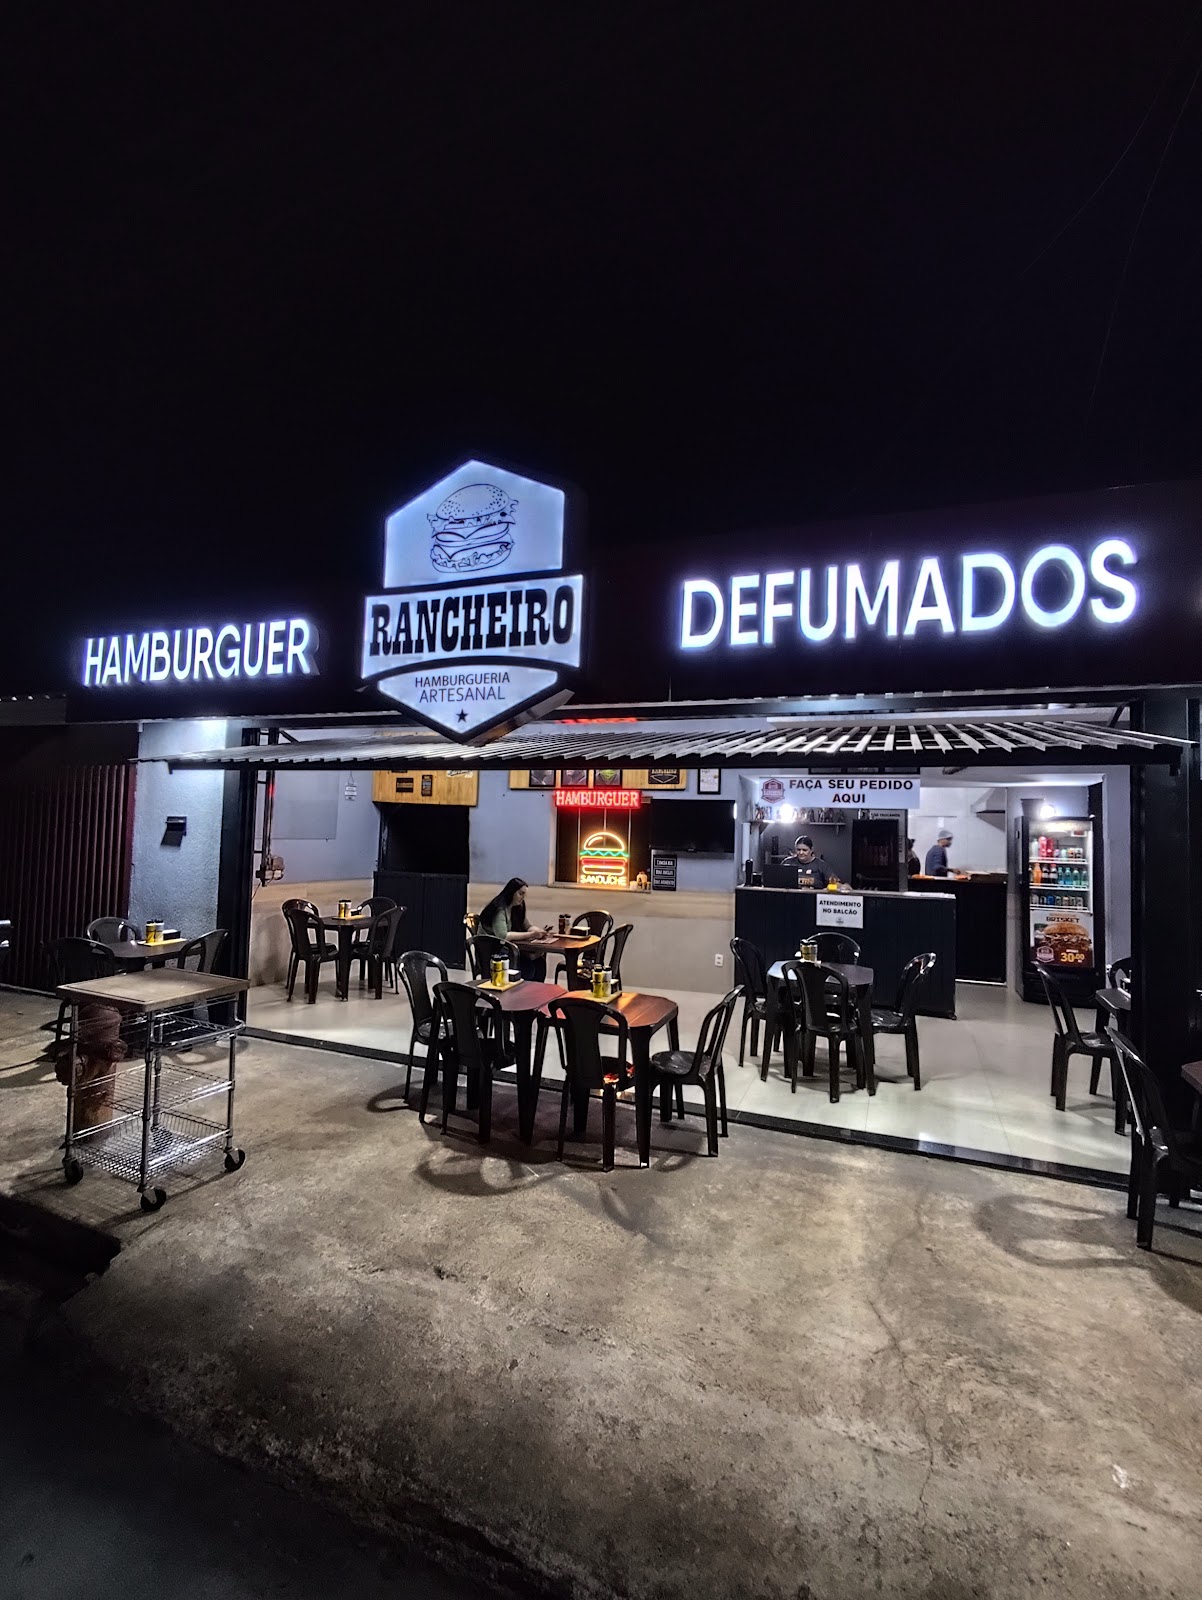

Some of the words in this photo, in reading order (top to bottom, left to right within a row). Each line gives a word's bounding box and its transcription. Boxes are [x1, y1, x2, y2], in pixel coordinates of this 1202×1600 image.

[679, 537, 1139, 650] DEFUMADOS
[369, 584, 575, 657] RANCHEIRO
[83, 618, 313, 687] HAMBURGUER
[415, 671, 511, 688] HAMBURGUERIA
[419, 685, 506, 704] ARTESANAL
[789, 779, 823, 792] FAÇA
[828, 779, 855, 790] SEU
[859, 780, 914, 791] PEDIDO
[556, 790, 639, 807] HAMBURGUER
[832, 793, 866, 803] AQUI
[819, 900, 862, 908] ATENDIMENTO
[833, 907, 858, 915] BALCÃO
